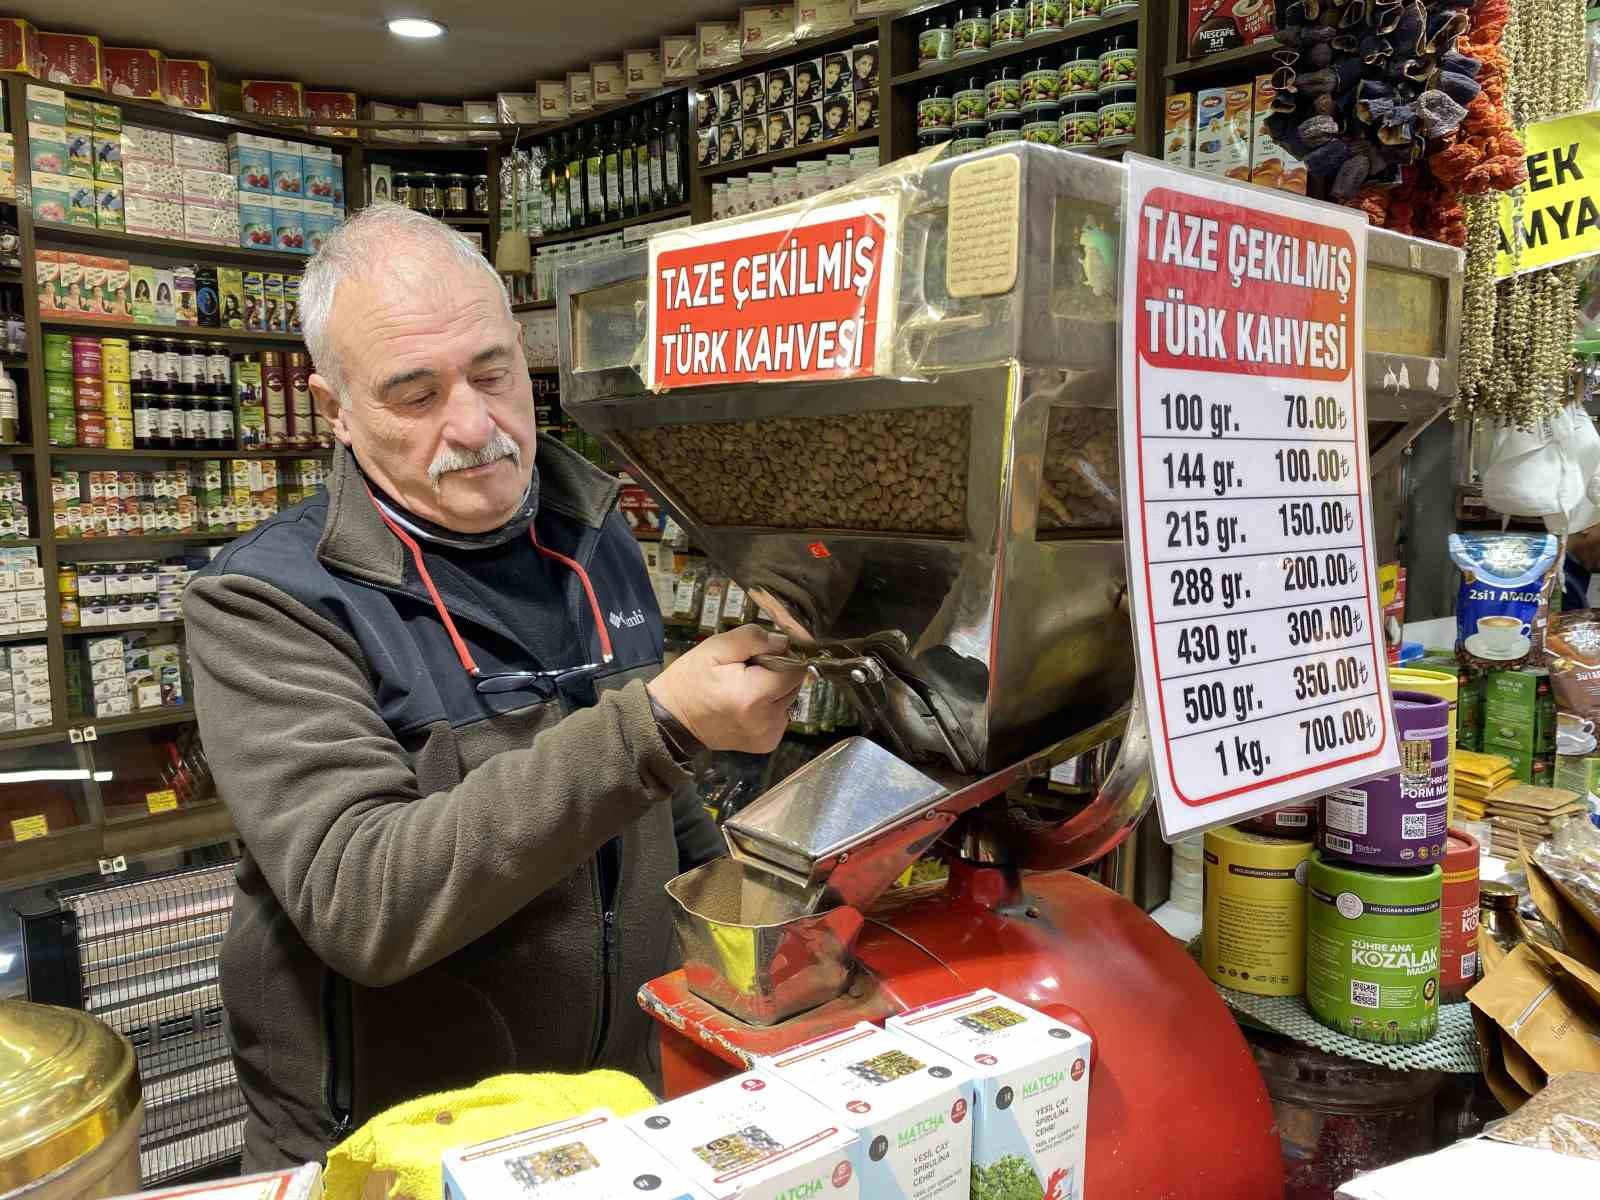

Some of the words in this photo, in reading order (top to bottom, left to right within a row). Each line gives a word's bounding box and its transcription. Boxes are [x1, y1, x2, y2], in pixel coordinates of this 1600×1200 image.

[1525, 143, 1584, 192] EK
[1144, 205, 1219, 272] TAZE
[1496, 196, 1600, 255] AMYA
[661, 261, 725, 310] TAZE
[732, 228, 876, 310] ÇEKİLMİŞ
[662, 322, 729, 376] TÜRK
[734, 306, 867, 374] KAHVESİ
[1144, 289, 1228, 360] TÜRK
[1236, 314, 1347, 370] KAHVESİ
[1161, 393, 1203, 431] 100
[1211, 400, 1240, 439] gr.
[1163, 452, 1206, 489] 144
[1213, 457, 1243, 496] gr.
[1166, 510, 1210, 548] 215
[1216, 515, 1247, 552] gr.
[1170, 567, 1214, 606] 288
[1221, 570, 1251, 609] gr.
[1177, 624, 1220, 664] 430
[1227, 625, 1257, 665] gr.
[1183, 681, 1227, 724] 500
[1233, 683, 1263, 722] gr.
[1214, 740, 1229, 776] 1
[1235, 736, 1271, 776] kg.
[1401, 787, 1434, 798] FORM
[1352, 938, 1388, 952] ZÜHRE
[1390, 943, 1412, 952] ANA
[1352, 946, 1438, 969] KOZALAK
[1022, 1070, 1065, 1094] MATCHA
[896, 1112, 945, 1144] MATCHA
